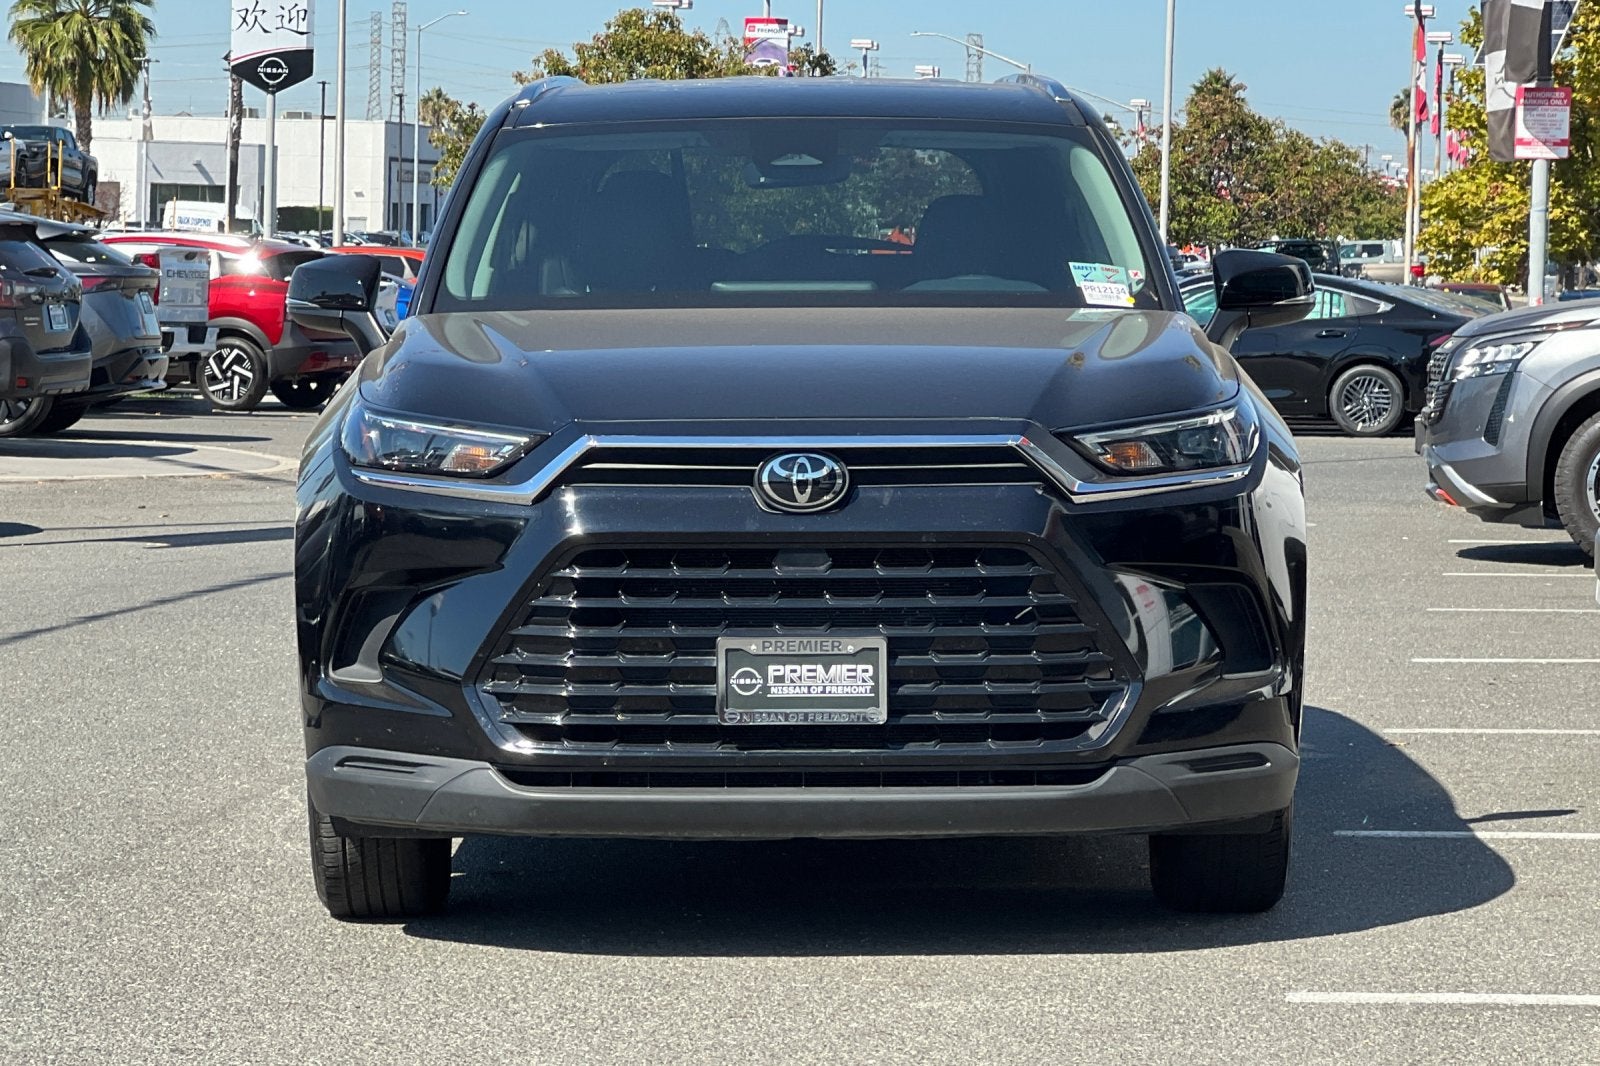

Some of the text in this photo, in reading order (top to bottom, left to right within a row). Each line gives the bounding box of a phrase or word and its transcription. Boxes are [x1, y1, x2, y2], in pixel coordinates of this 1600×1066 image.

[236, 0, 311, 35] 欢迎
[1100, 266, 1120, 274] SMOG
[1083, 285, 1127, 295] PR12134
[761, 640, 843, 652] PREMIER
[767, 664, 874, 684] PREMIER
[770, 686, 871, 694] NISSAN OF FREMONT
[741, 712, 784, 723] NISSAN
[788, 712, 805, 723] OF
[808, 712, 865, 723] FREMONT
